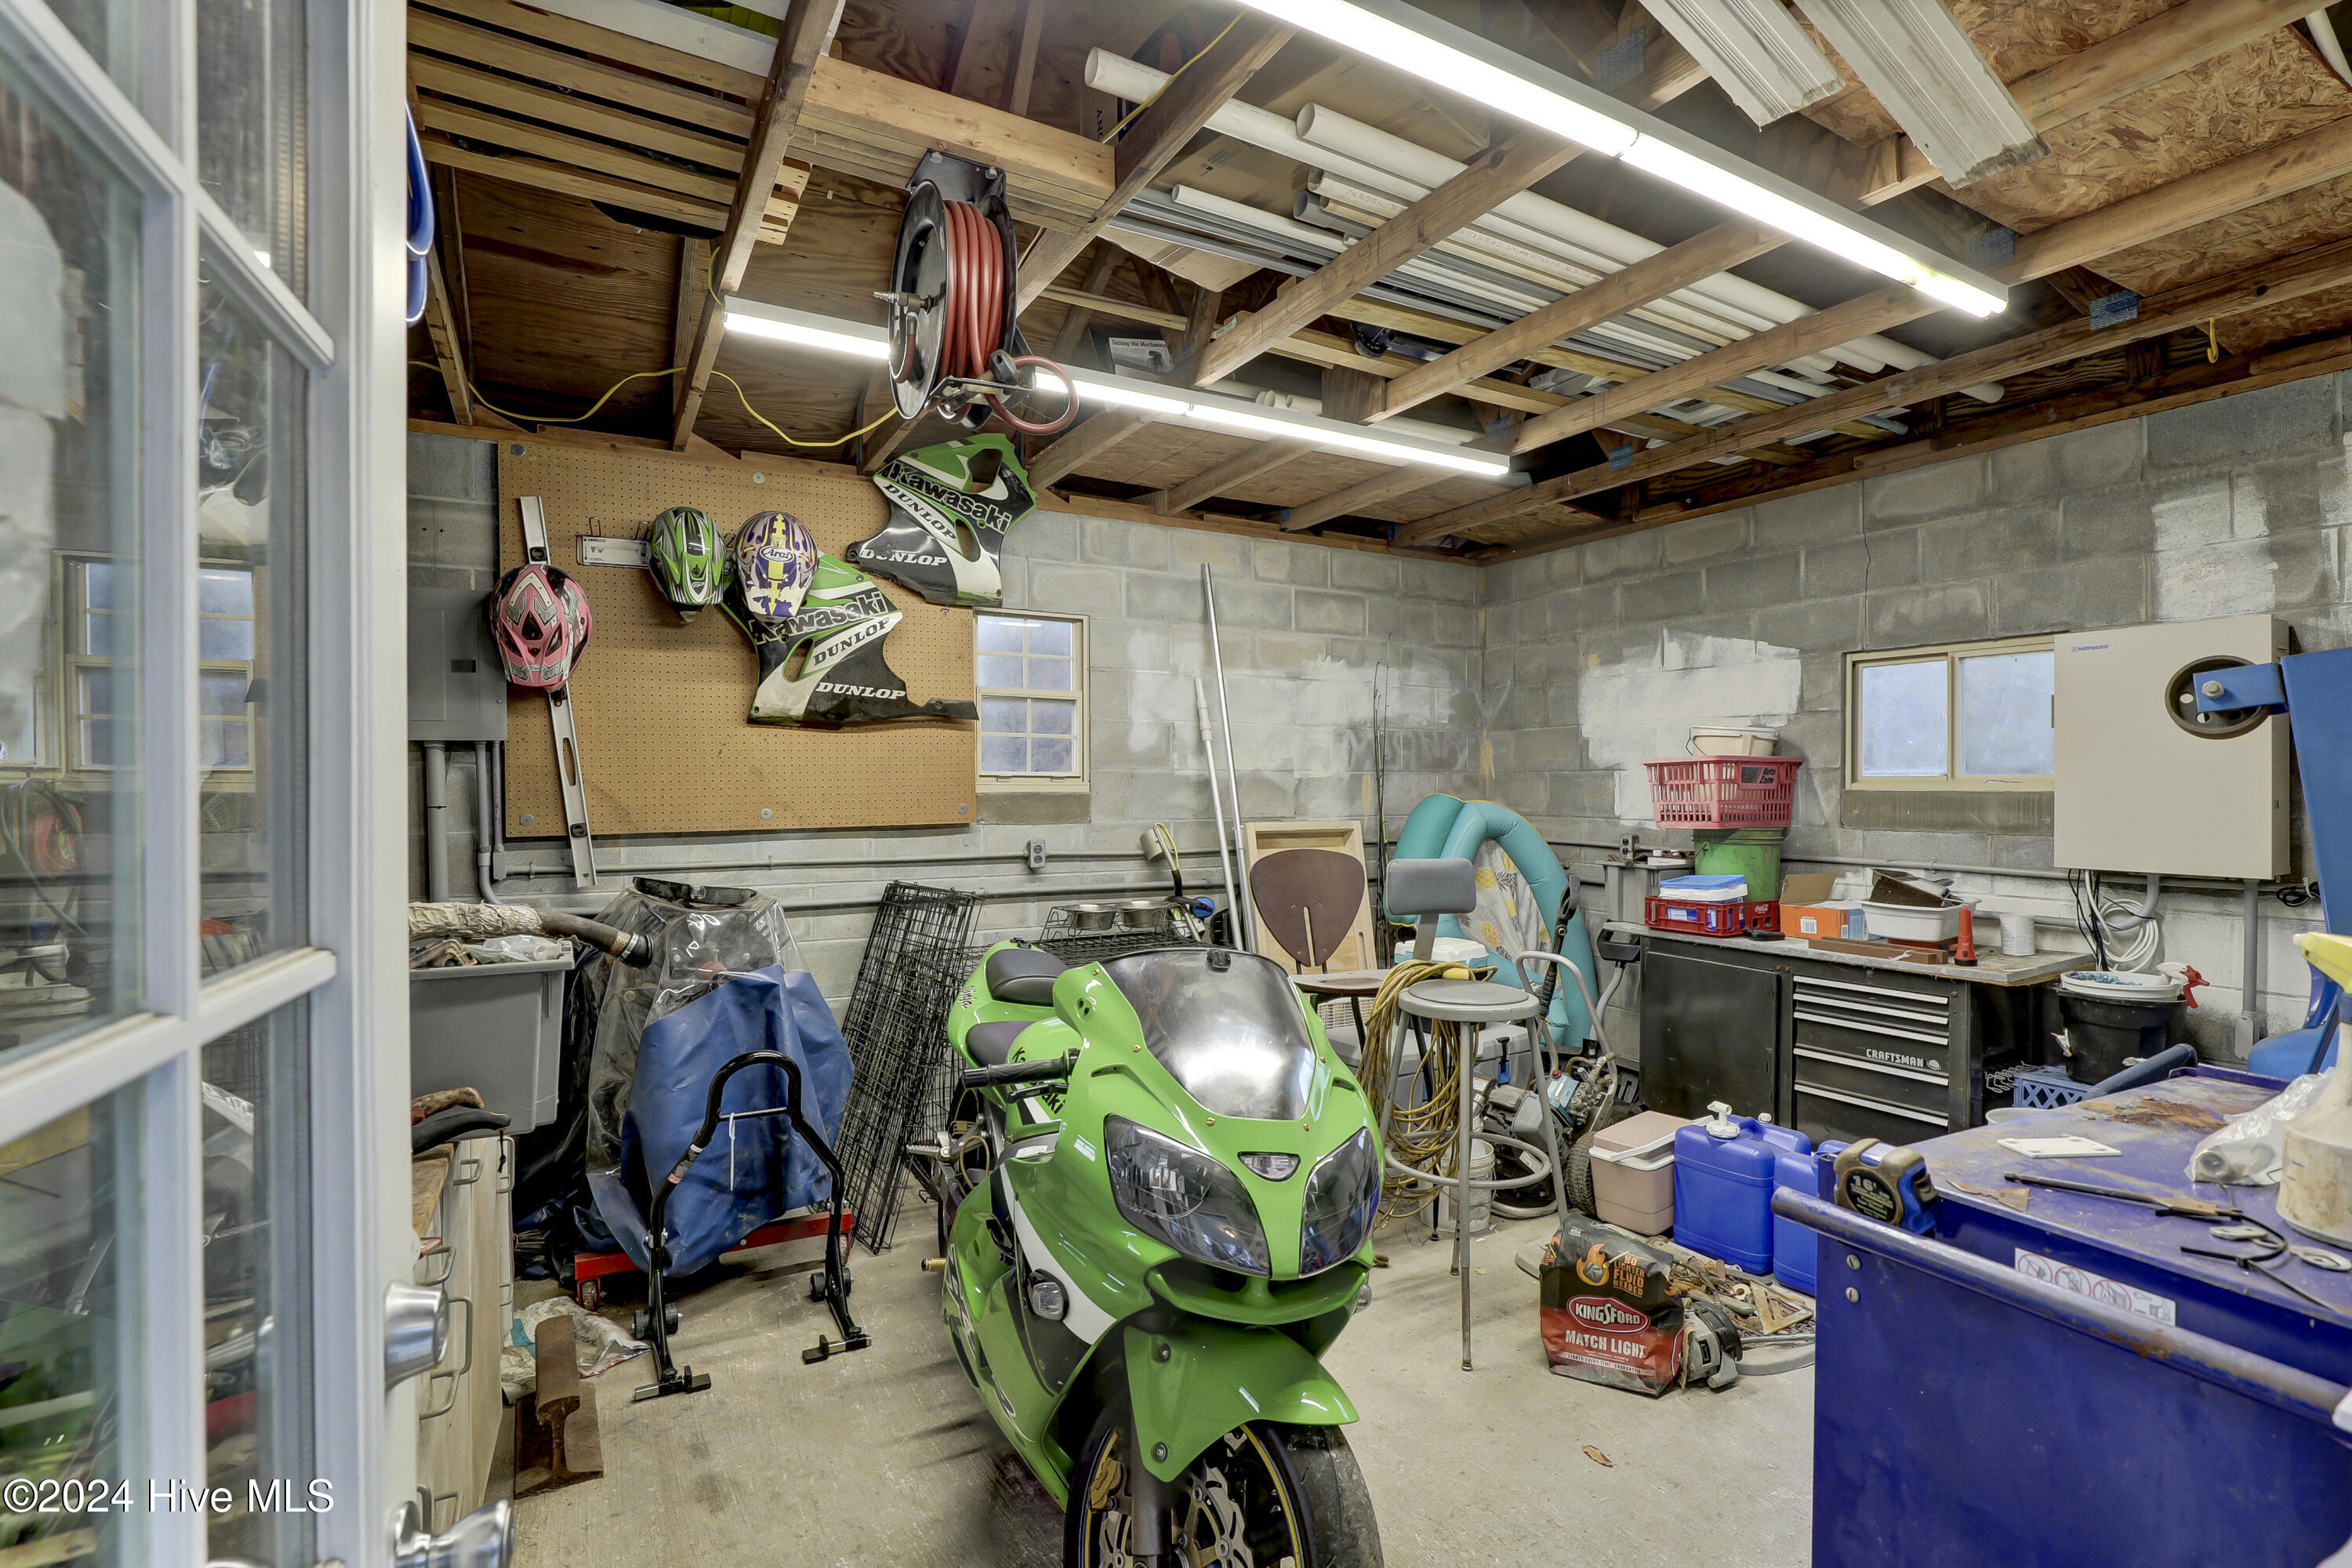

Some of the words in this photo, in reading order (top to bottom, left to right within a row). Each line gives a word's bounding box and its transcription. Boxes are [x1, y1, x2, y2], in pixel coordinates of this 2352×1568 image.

[891, 461, 1013, 535] Kawasaki
[883, 483, 956, 539] DUNLOP
[859, 549, 947, 566] DNLOP
[812, 617, 890, 666] DUNLOP
[815, 682, 906, 699] DUNLOP
[1866, 1049, 1924, 1067] CRAFTSMAN
[1613, 1261, 1645, 1276] LIGHTER
[1624, 1254, 1638, 1266] NO
[1613, 1269, 1644, 1288] FLUID
[1613, 1279, 1643, 1296] NEEDED
[1575, 1302, 1642, 1325] KINGSFORD
[1565, 1330, 1607, 1351] MATCH
[1610, 1338, 1646, 1359] LIGHT
